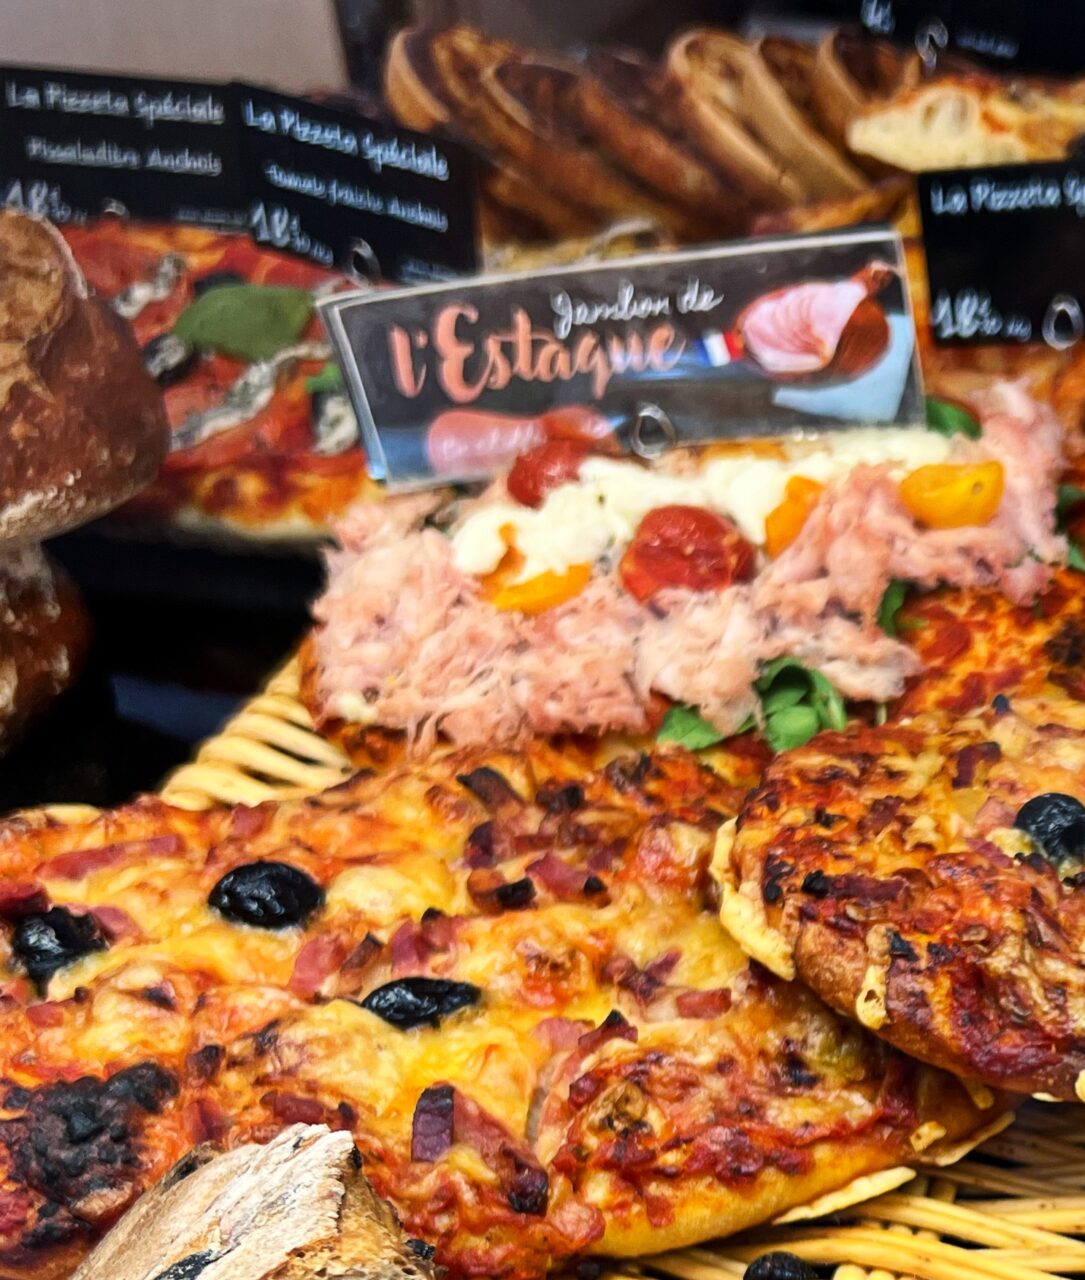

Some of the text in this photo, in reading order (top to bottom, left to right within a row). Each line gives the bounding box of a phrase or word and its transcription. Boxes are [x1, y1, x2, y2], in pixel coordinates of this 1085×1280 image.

[8, 81, 41, 110] La
[133, 91, 225, 129] Spéciale
[144, 147, 222, 176] Anchois
[241, 99, 277, 132] La
[360, 129, 449, 182] Spéciale
[929, 180, 968, 216] La
[550, 273, 726, 340] Jambon de
[388, 303, 686, 401] l'Estaque
